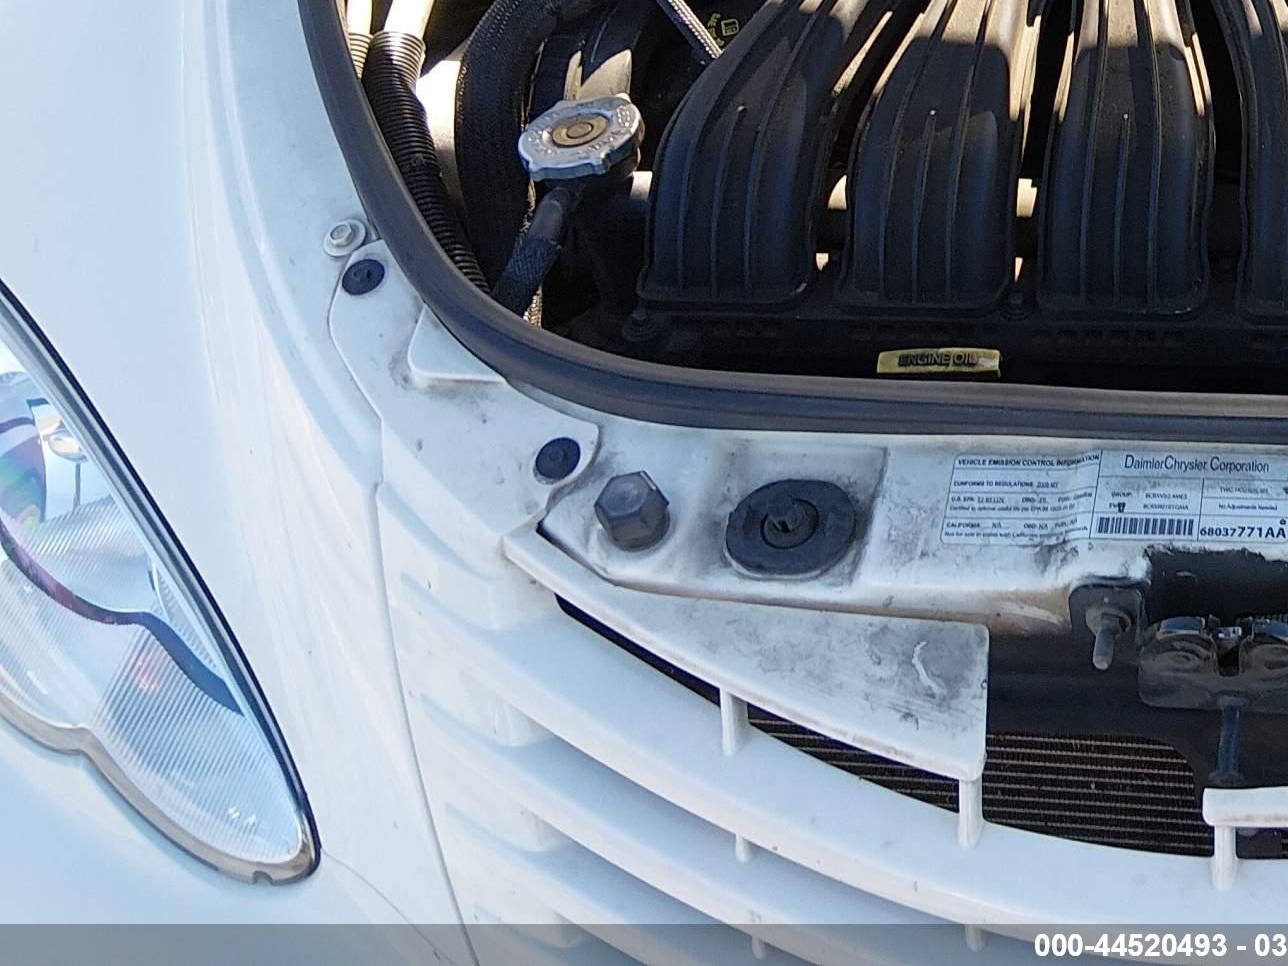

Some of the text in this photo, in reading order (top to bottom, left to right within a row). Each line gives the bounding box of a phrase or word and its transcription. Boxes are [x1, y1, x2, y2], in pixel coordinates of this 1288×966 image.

[897, 353, 978, 366] ENGINE OIL
[958, 453, 1099, 466] VEHICLE EMISSION CONTROL INFORMATION
[1124, 454, 1269, 474] DaimlerChrysler Corporation
[1200, 526, 1286, 539] 68037771AA
